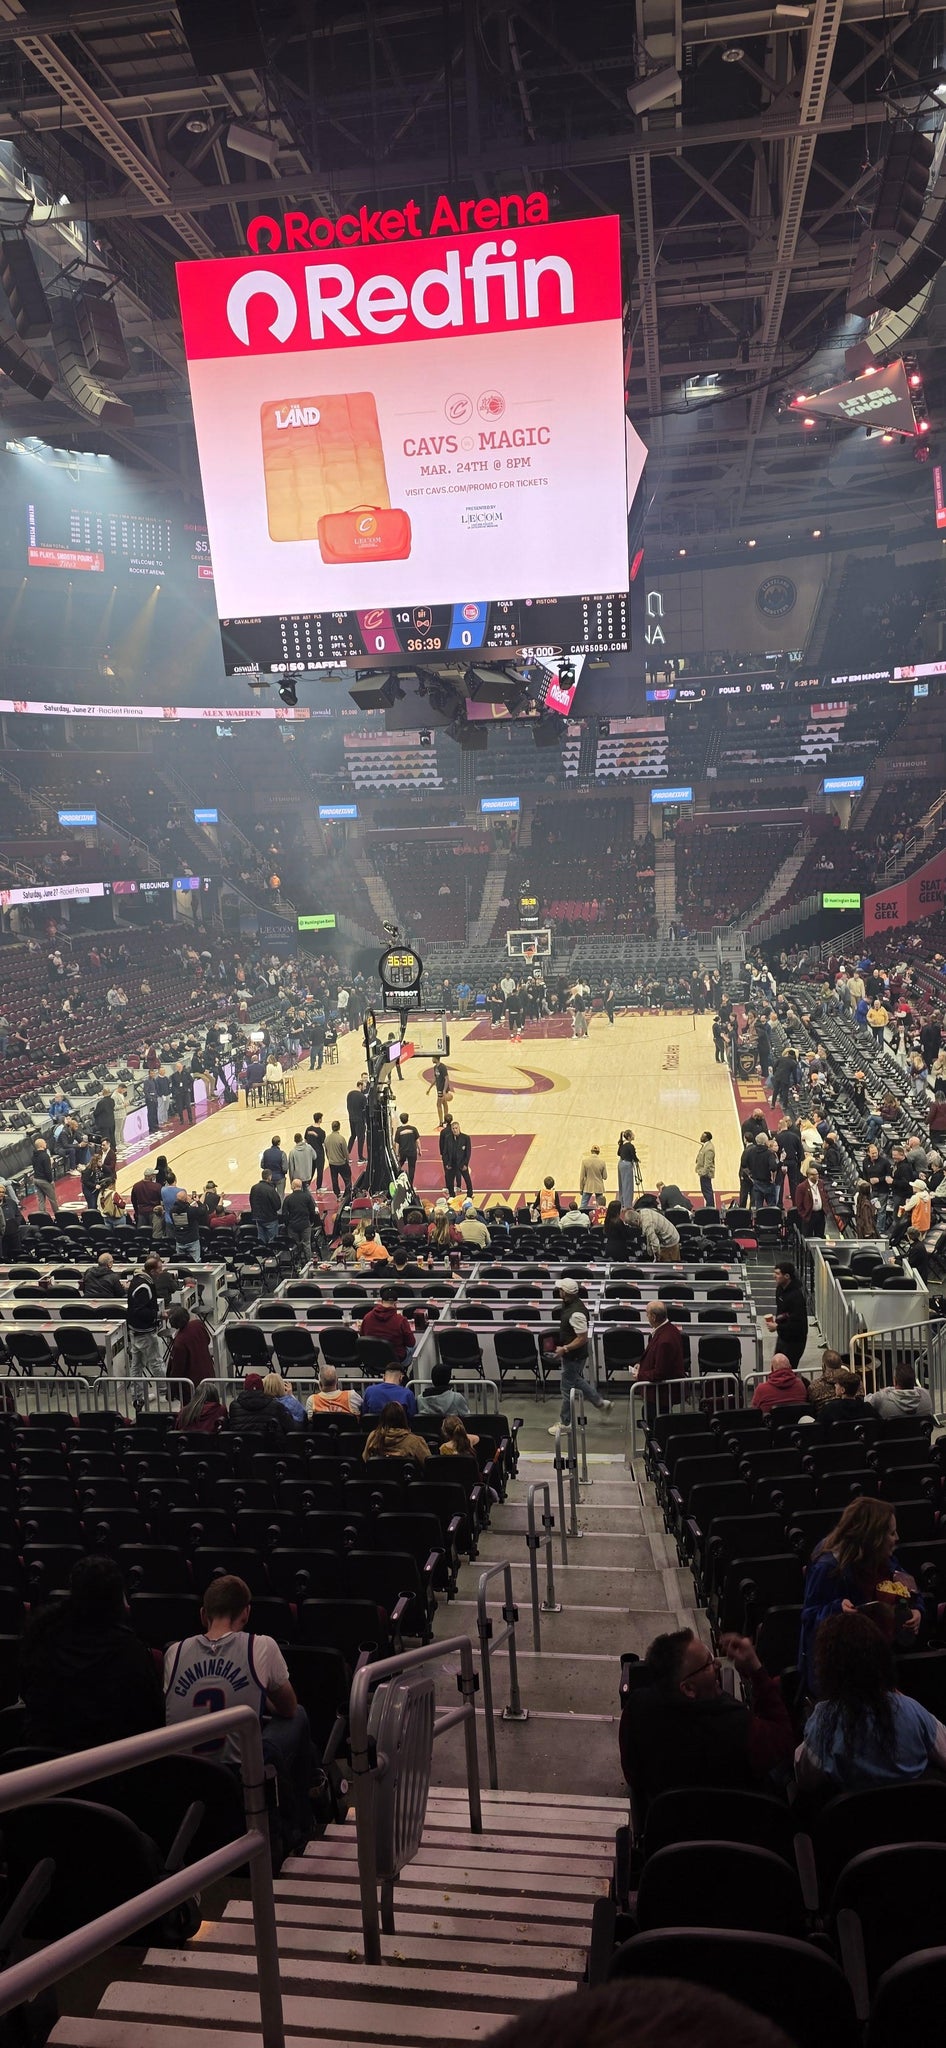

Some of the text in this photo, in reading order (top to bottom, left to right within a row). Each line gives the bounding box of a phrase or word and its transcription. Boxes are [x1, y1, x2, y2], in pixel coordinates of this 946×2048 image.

[284, 191, 549, 251] Rocket Arena
[304, 239, 575, 340] Redfin
[838, 386, 893, 410] LET EM
[274, 407, 321, 430] LAND
[403, 426, 551, 457] CAVS MAGIC
[420, 457, 531, 476] MAR. 24TH @ 8PM
[405, 478, 549, 497] VISIT CAVS.COM/PROMO FOR TICKETS
[396, 612, 410, 623] 1Q
[375, 630, 471, 651] 0 36:39 0
[233, 662, 260, 673] oswald
[308, 660, 347, 670] RAFFLE
[571, 642, 628, 653] CAVS5050.COM
[719, 686, 740, 694] FOULS
[44, 705, 71, 714] Saturday,
[72, 706, 87, 714] June
[920, 879, 942, 891] SEAT
[876, 902, 898, 911] SEAT
[919, 891, 944, 903] GEEK
[874, 910, 899, 920] GEEK
[387, 956, 414, 966] 36:38
[175, 1658, 249, 1698] CUNNINGHAM
